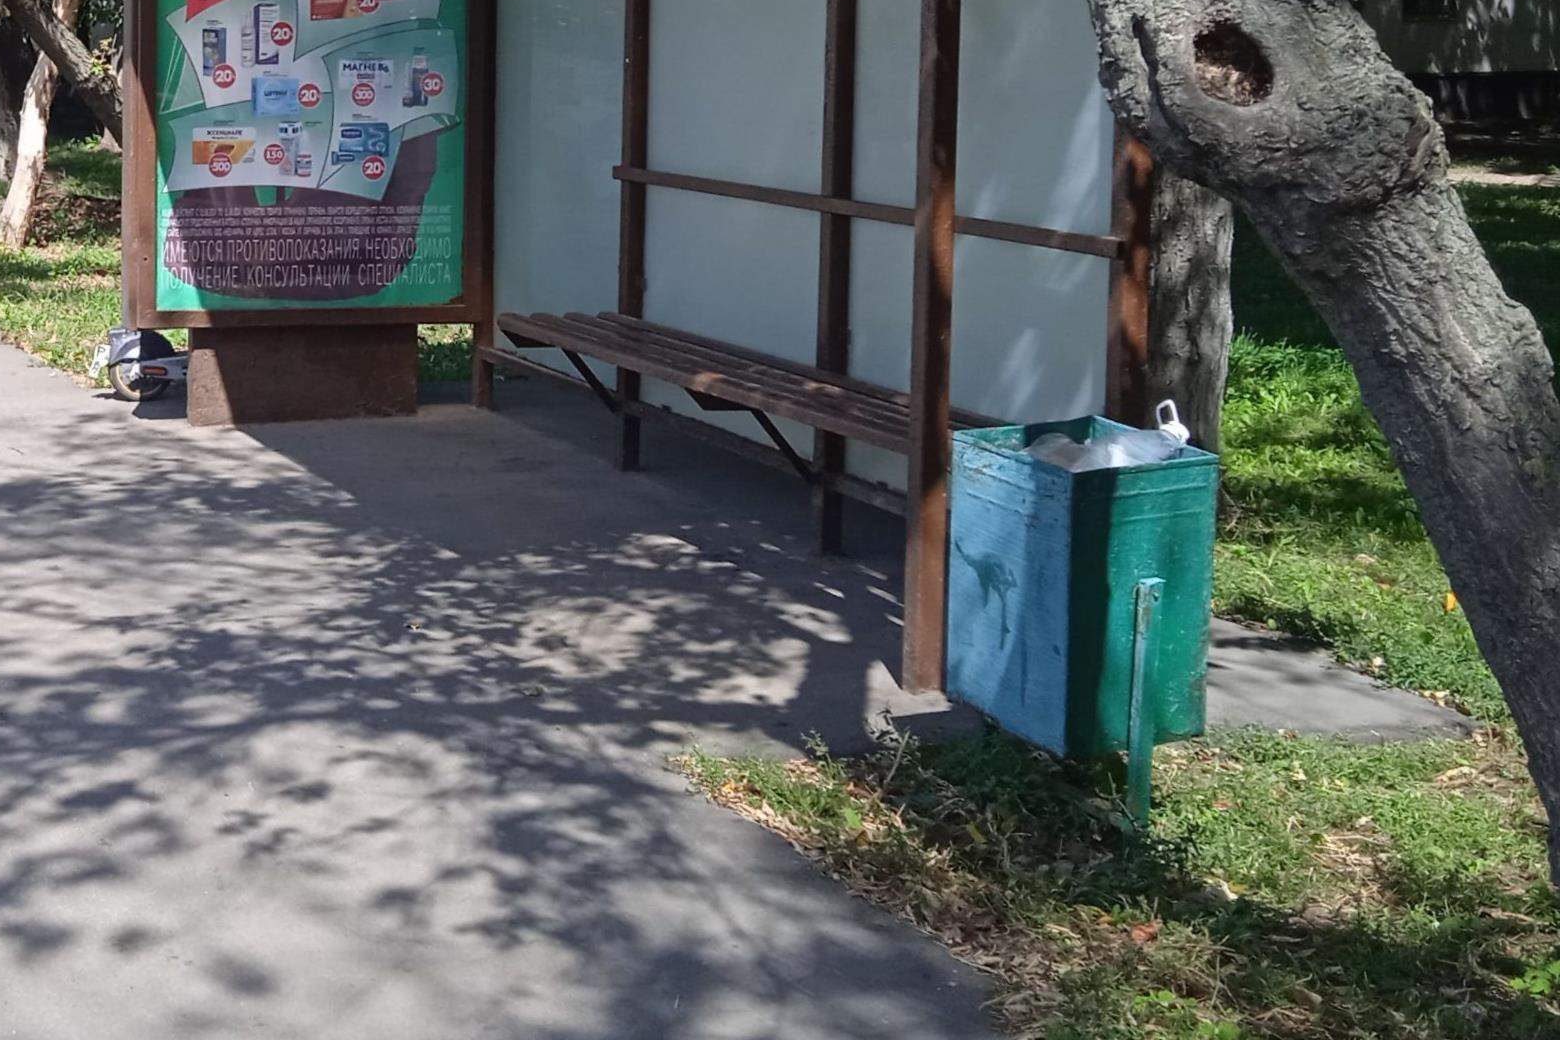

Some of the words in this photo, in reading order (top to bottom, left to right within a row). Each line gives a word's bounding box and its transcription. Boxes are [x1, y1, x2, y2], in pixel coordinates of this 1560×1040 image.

[365, 236, 452, 261] НЕОБХОДИМО
[247, 263, 350, 288] КОНСУЛЬТАЦИИ
[358, 262, 452, 286] СПЕЦИАЛИСТА
